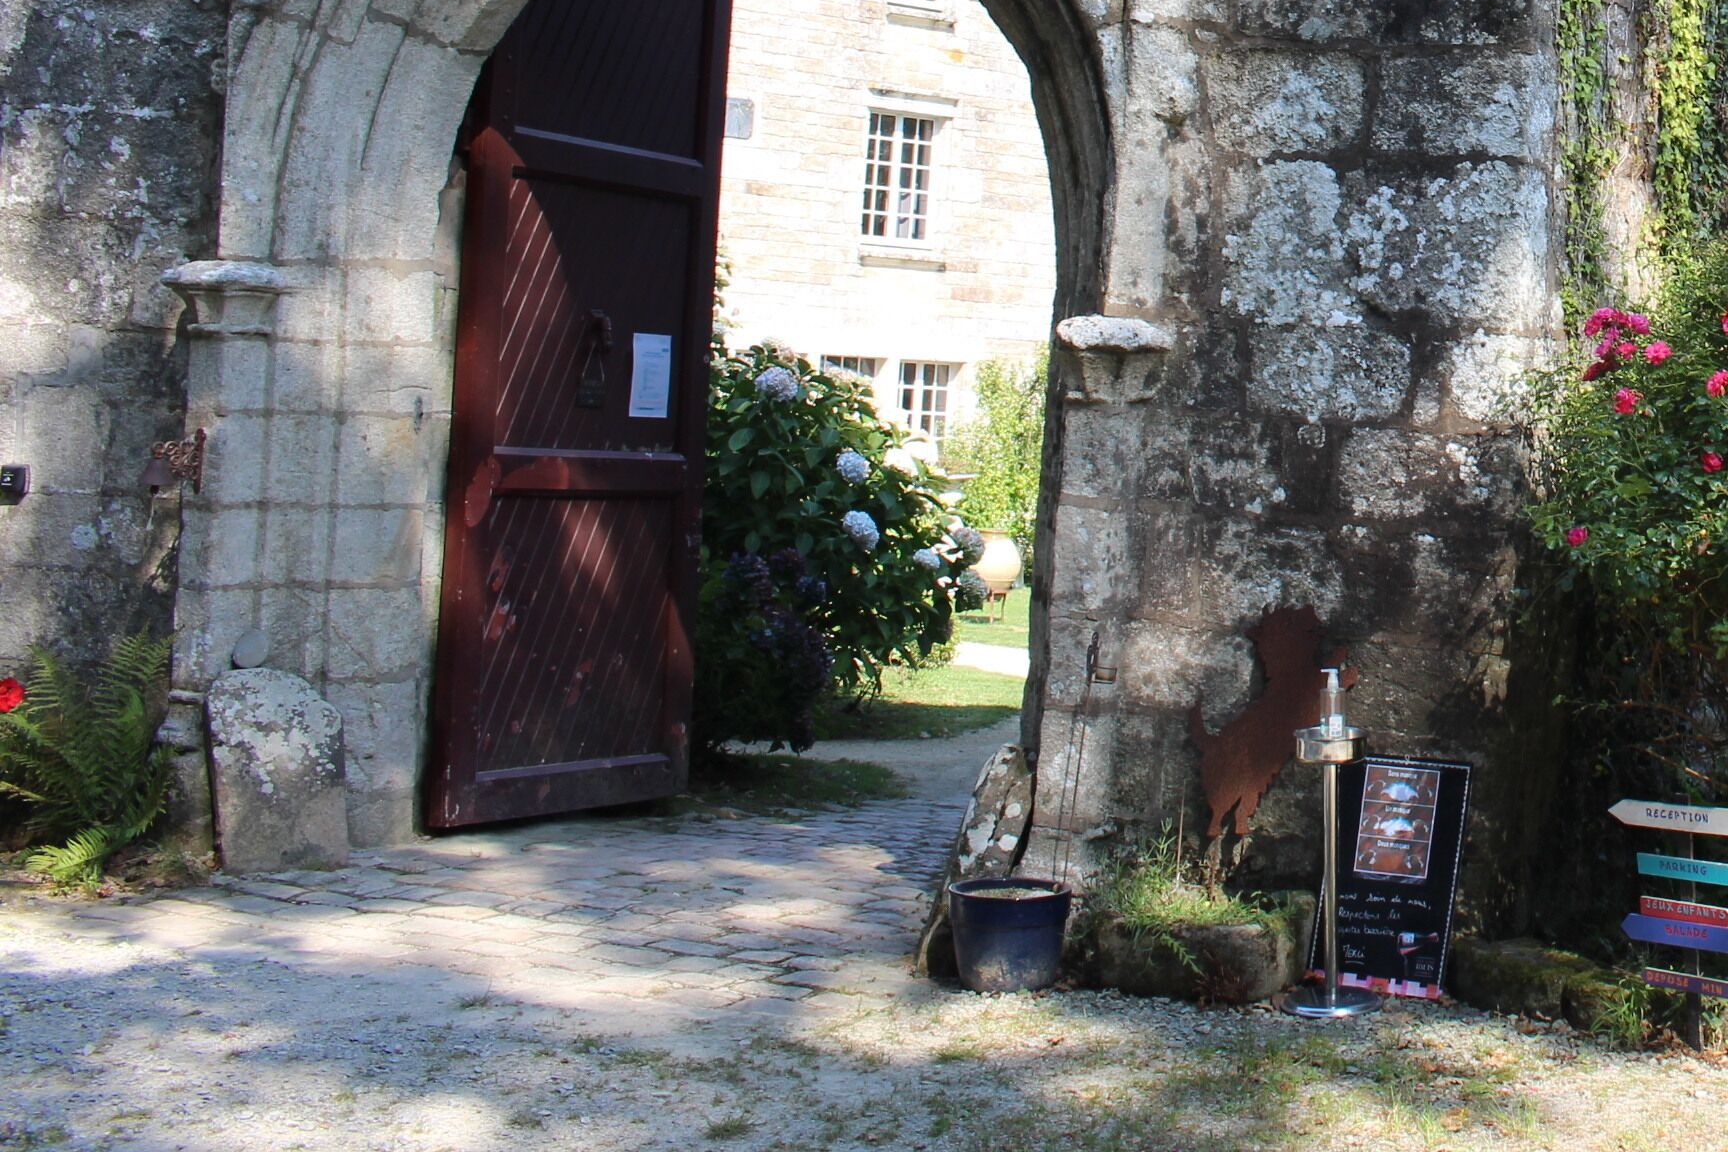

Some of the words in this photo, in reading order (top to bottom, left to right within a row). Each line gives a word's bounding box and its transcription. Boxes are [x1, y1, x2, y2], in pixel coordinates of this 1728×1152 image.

[1645, 807, 1709, 823] RECEPTION
[1659, 860, 1707, 877] PARKING
[1646, 899, 1674, 912] JEUX
[1663, 923, 1709, 940] BALADE
